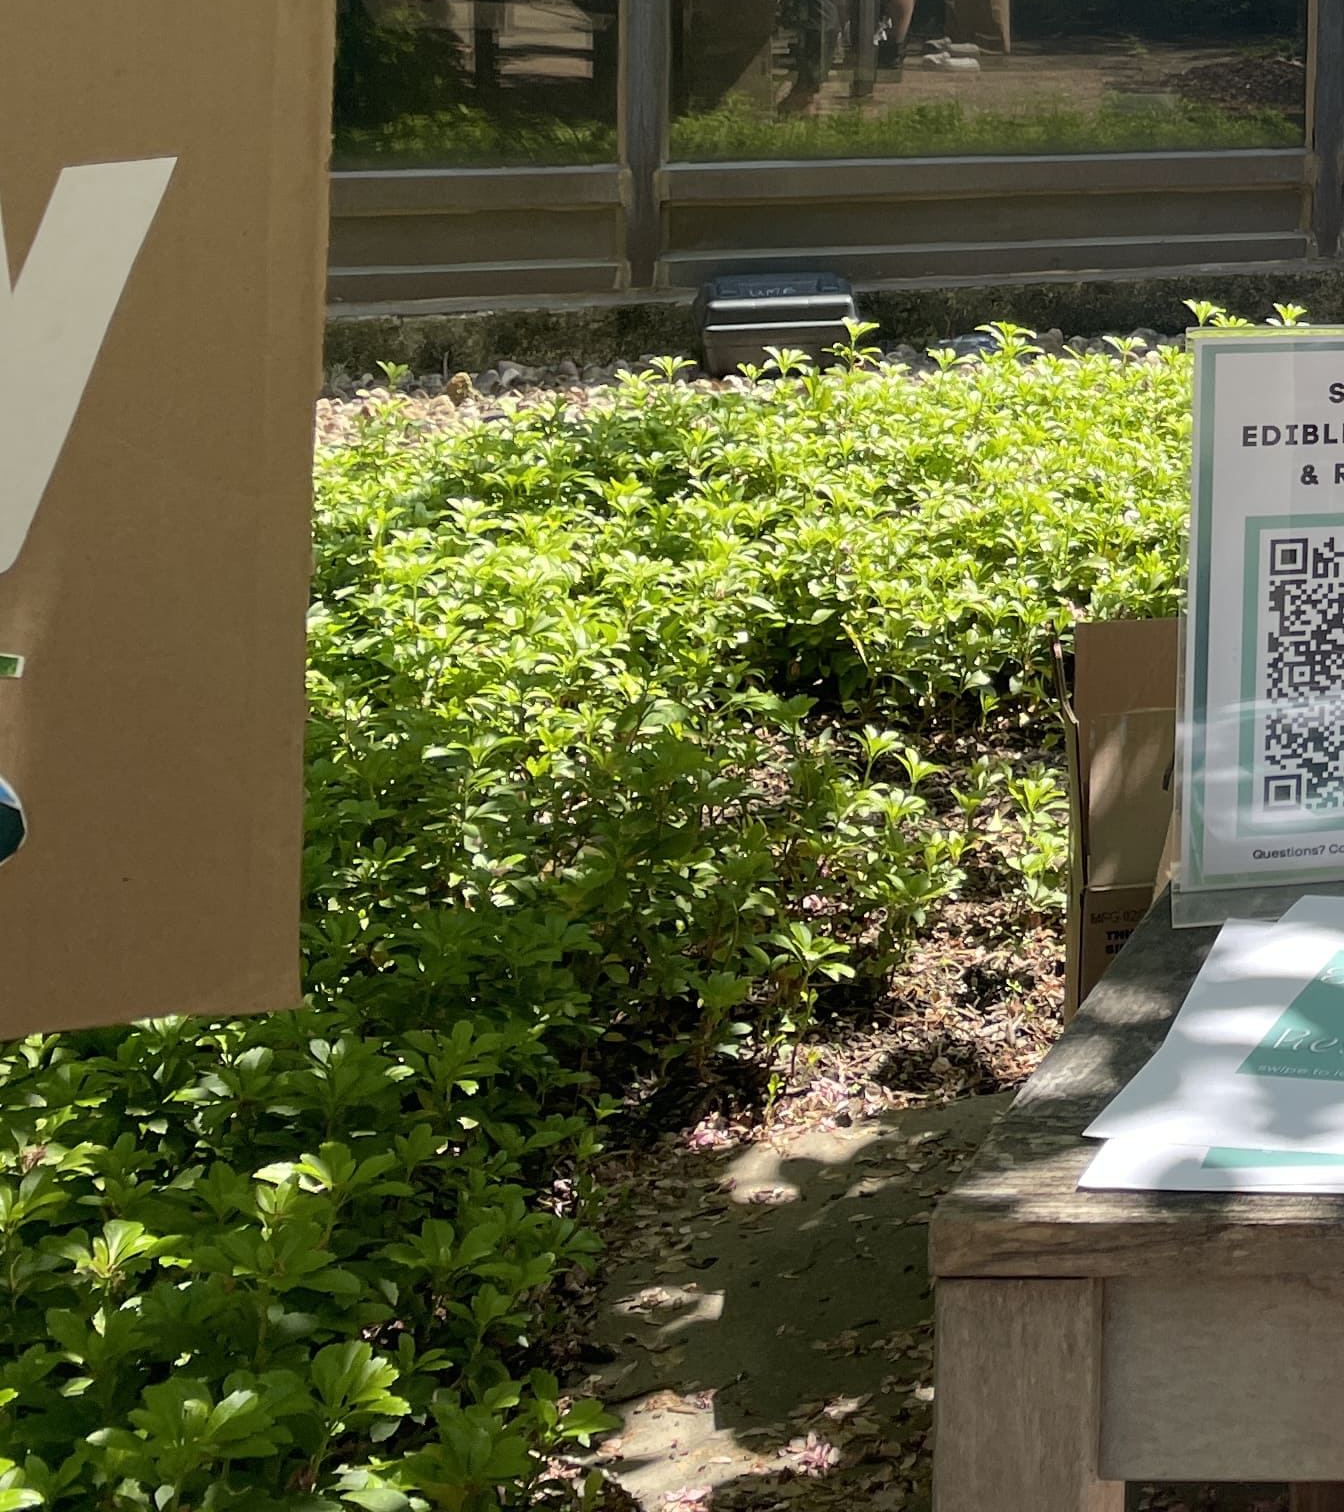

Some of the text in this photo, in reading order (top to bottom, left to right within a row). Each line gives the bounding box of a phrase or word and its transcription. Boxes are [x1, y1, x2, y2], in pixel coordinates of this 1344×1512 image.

[1300, 464, 1319, 486] &
[1252, 844, 1326, 860] Questions?
[1257, 1064, 1309, 1076] swipe
[1312, 1067, 1329, 1076] to
